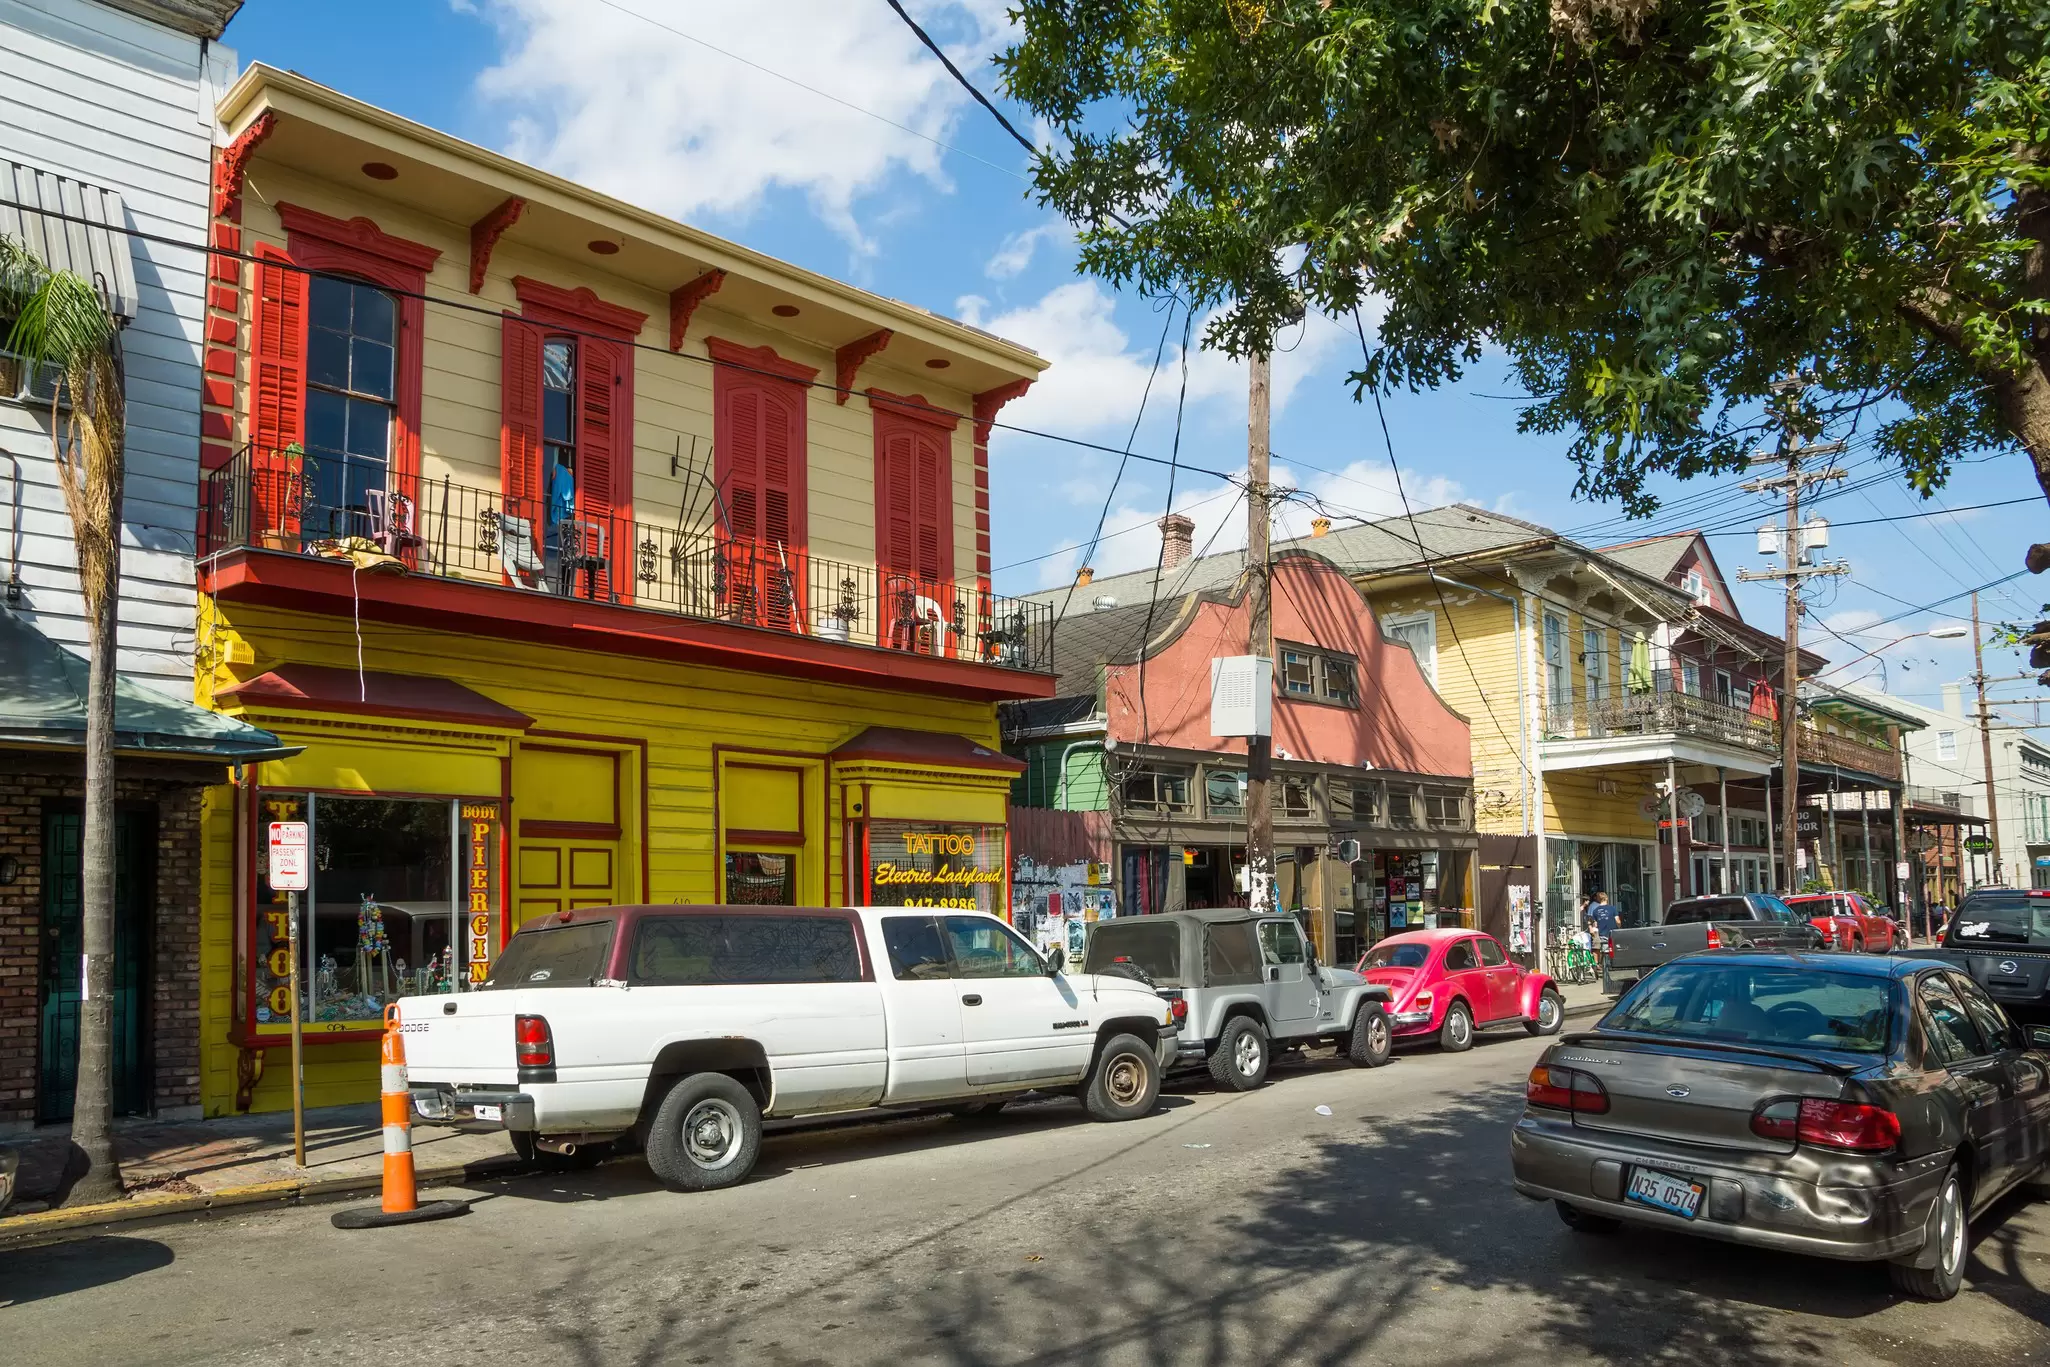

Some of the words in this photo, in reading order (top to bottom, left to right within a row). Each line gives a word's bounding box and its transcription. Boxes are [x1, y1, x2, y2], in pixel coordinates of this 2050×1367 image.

[462, 805, 496, 819] BODY
[271, 828, 281, 841] NO
[1775, 822, 1818, 833] HBOR
[903, 832, 975, 855] TATTOO
[875, 863, 932, 884] Electric
[933, 864, 1002, 887] Ladyland
[266, 801, 298, 1014] TTOO
[469, 822, 491, 983] PIERCIN
[903, 897, 977, 911] 947-8286
[1635, 1157, 1698, 1172] CHEVROLET
[1631, 1175, 1660, 1199] N35
[1663, 1186, 1697, 1213] 0574
